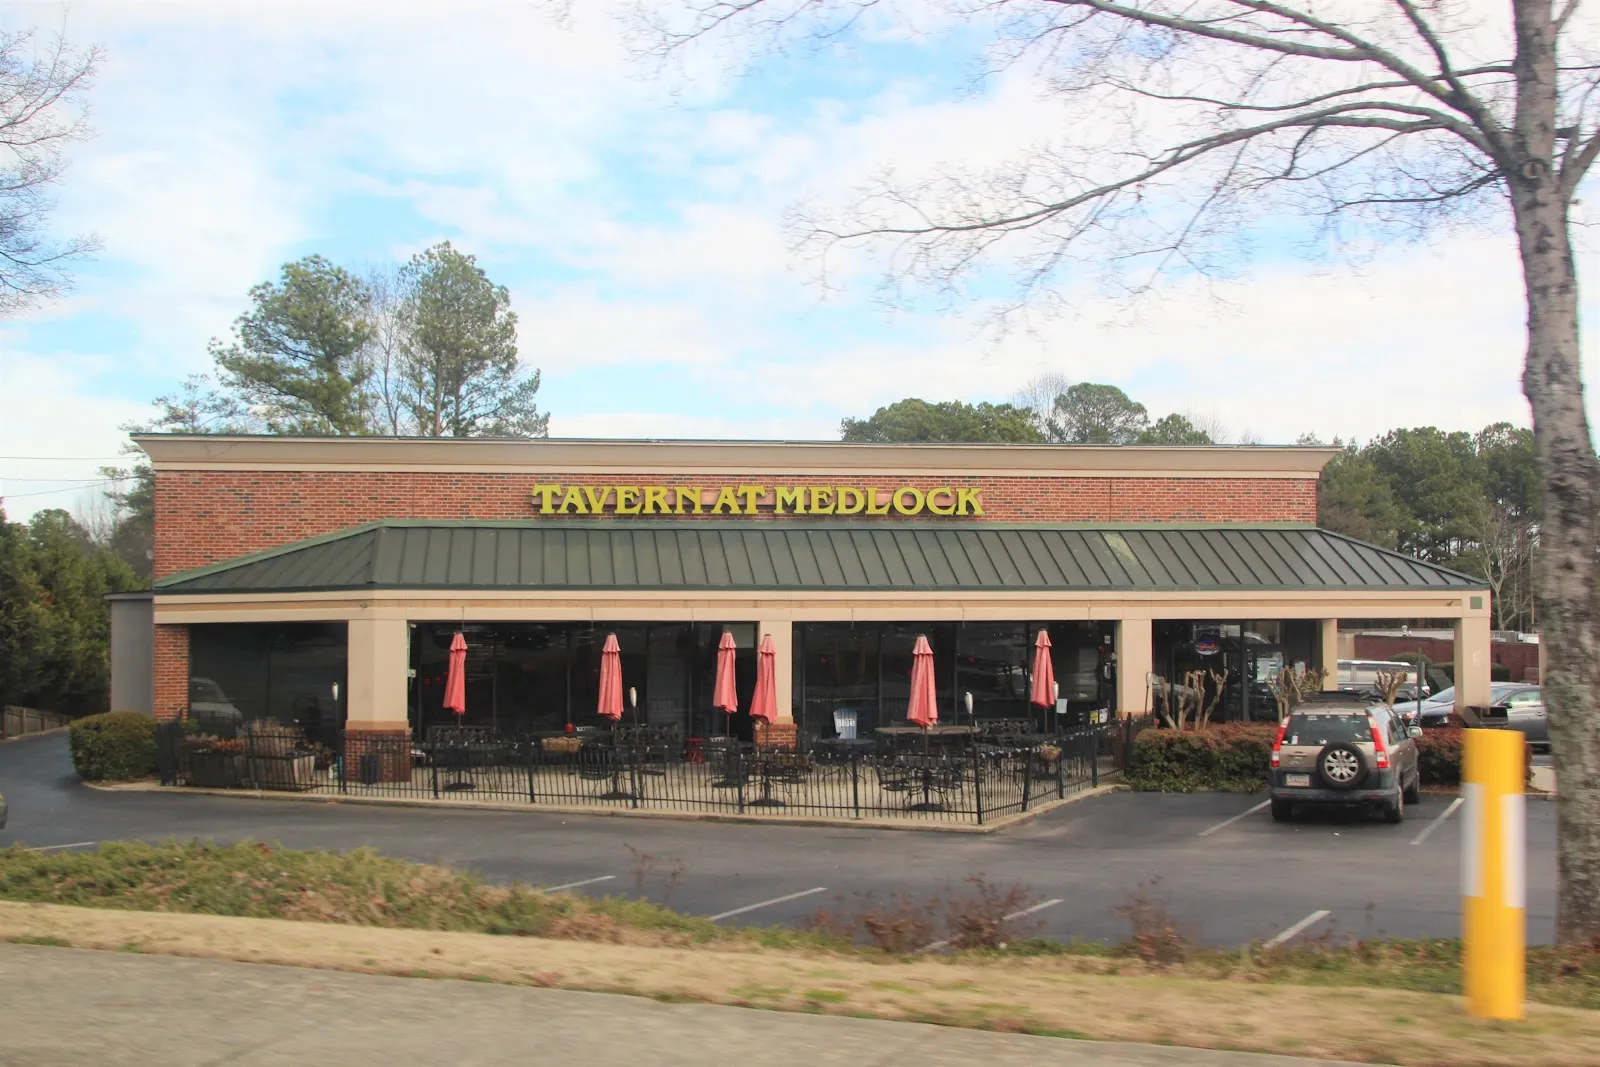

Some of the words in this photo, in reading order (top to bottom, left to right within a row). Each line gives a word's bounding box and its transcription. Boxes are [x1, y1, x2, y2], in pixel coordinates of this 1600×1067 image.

[532, 483, 703, 515] TAVERN
[711, 483, 766, 515] AT
[774, 485, 985, 516] MEDLOCK
[836, 718, 856, 727] Blue
